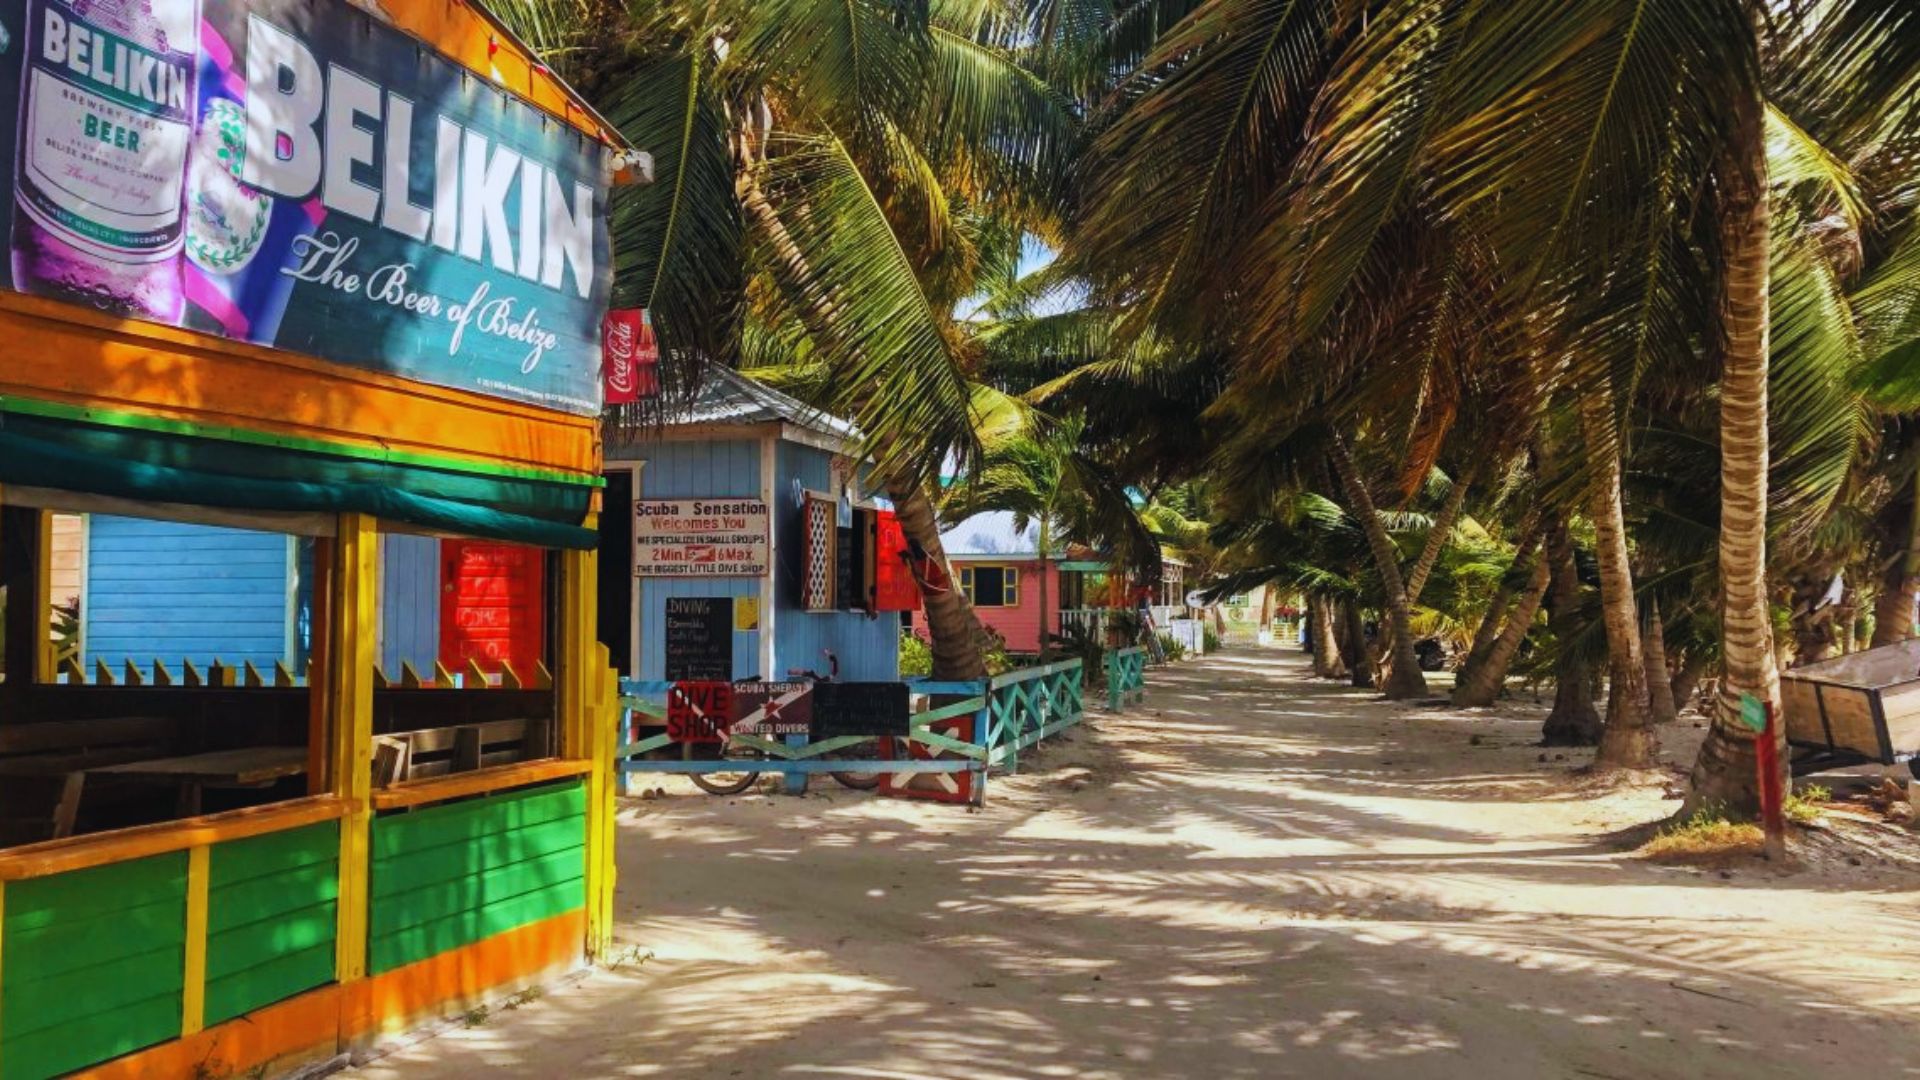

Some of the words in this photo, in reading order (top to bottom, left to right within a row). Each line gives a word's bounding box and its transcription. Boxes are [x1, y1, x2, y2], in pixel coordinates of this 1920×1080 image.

[43, 7, 186, 111] BELIKIN
[62, 88, 123, 119] BREWERY
[84, 112, 141, 154] BEER
[242, 12, 595, 299] BELIKIN
[280, 231, 360, 293] The
[366, 264, 442, 317] Beer
[447, 282, 491, 356] of
[477, 297, 557, 374] Belize
[636, 503, 679, 516] Scuba
[693, 502, 767, 515] Sensation
[651, 517, 719, 530] Welcomes
[722, 517, 746, 529] You
[696, 535, 705, 545] IN
[705, 535, 730, 545] SMALL
[731, 534, 765, 544] GROUPS
[652, 548, 660, 561] 2
[718, 548, 725, 561] 6
[637, 565, 653, 574] THE
[654, 564, 688, 574] BIGGEST
[690, 564, 716, 574] LITTLE
[718, 563, 738, 573] DIVE
[740, 564, 765, 574] SHOP
[734, 684, 765, 694] SCUBA
[671, 686, 726, 711] DIVE
[669, 713, 727, 738] SHOP
[776, 723, 810, 734] DIVERS
